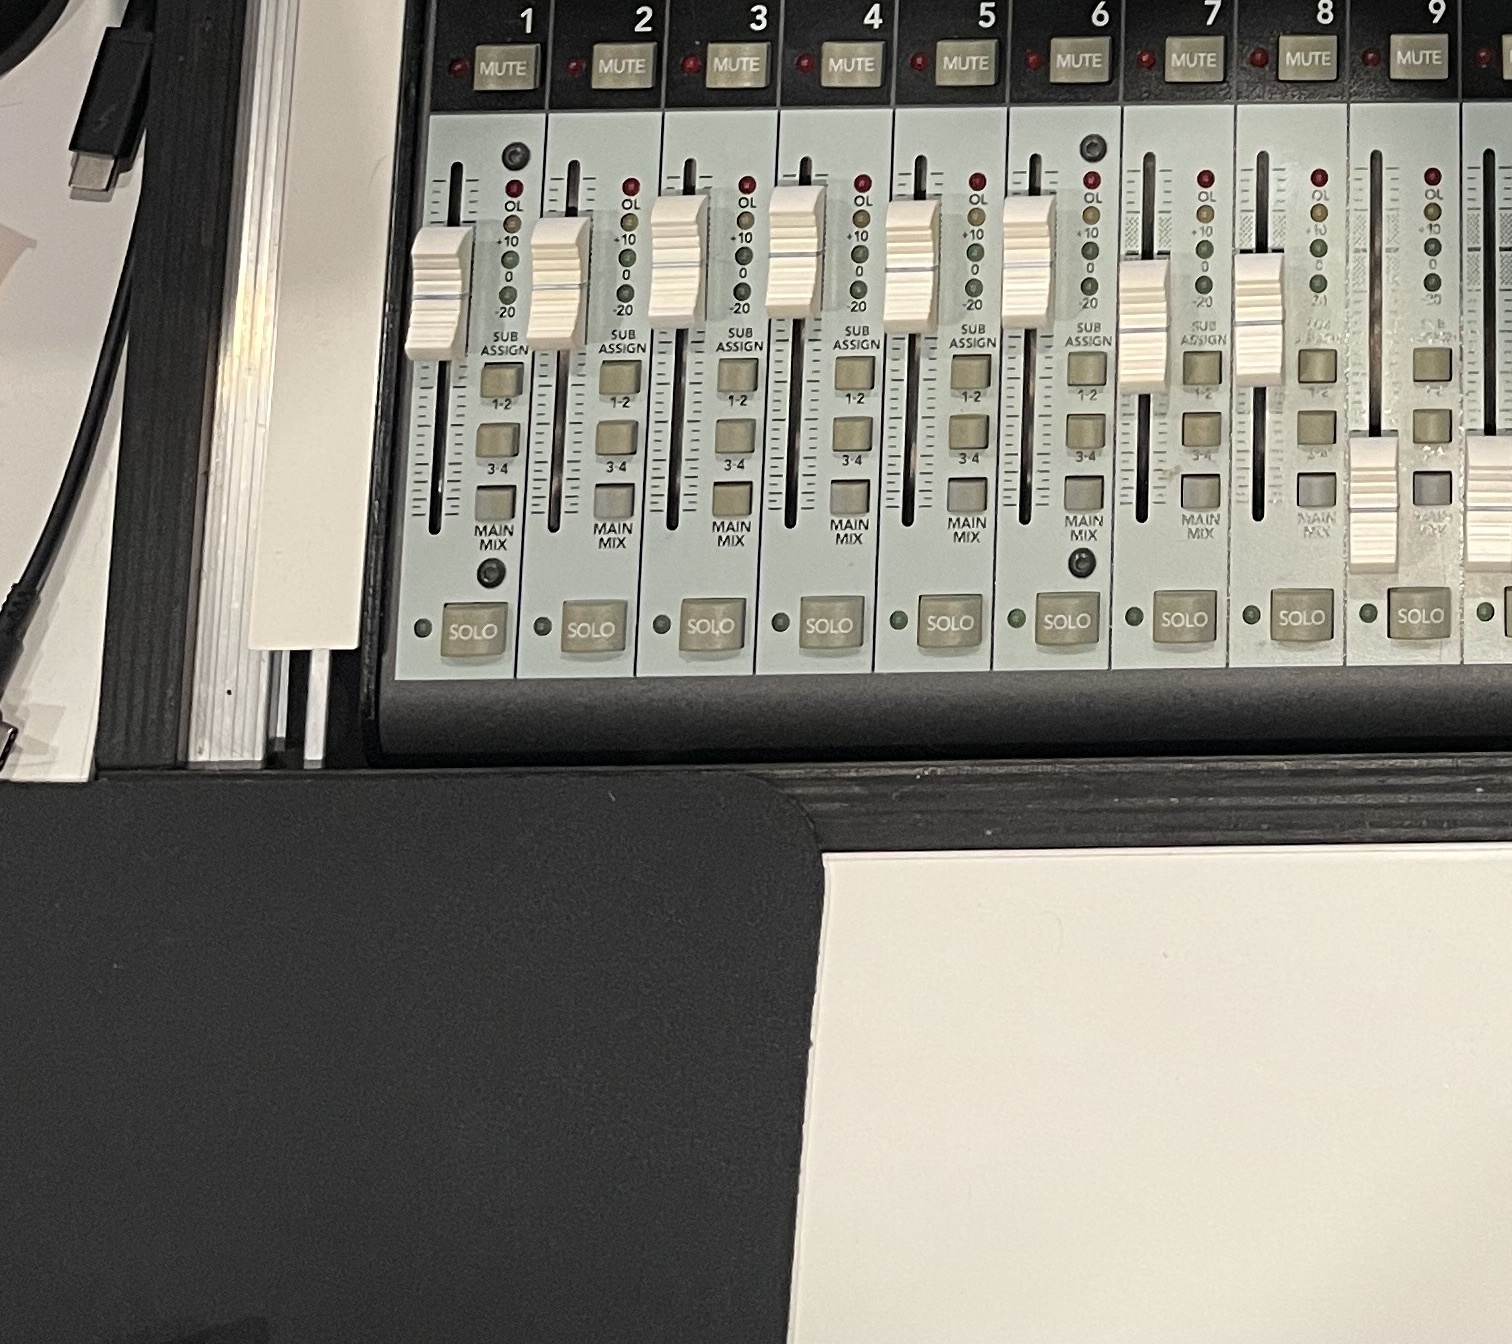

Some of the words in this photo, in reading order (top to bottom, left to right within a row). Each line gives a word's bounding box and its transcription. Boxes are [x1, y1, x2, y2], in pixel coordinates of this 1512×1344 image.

[635, 6, 652, 31] 2
[864, 4, 882, 29] 4
[1092, 1, 1109, 26] 6
[1205, 0, 1221, 25] 7
[521, 8, 532, 33] 1
[829, 58, 874, 72] MUTE
[1396, 48, 1441, 68] MUTE
[480, 61, 526, 76] MUTE
[493, 332, 518, 342] SUB
[481, 345, 529, 356] ASSIGN
[490, 397, 512, 409] 1-2
[475, 524, 513, 536] MAIN
[480, 539, 506, 551] MIX
[450, 624, 497, 640] SOLO
